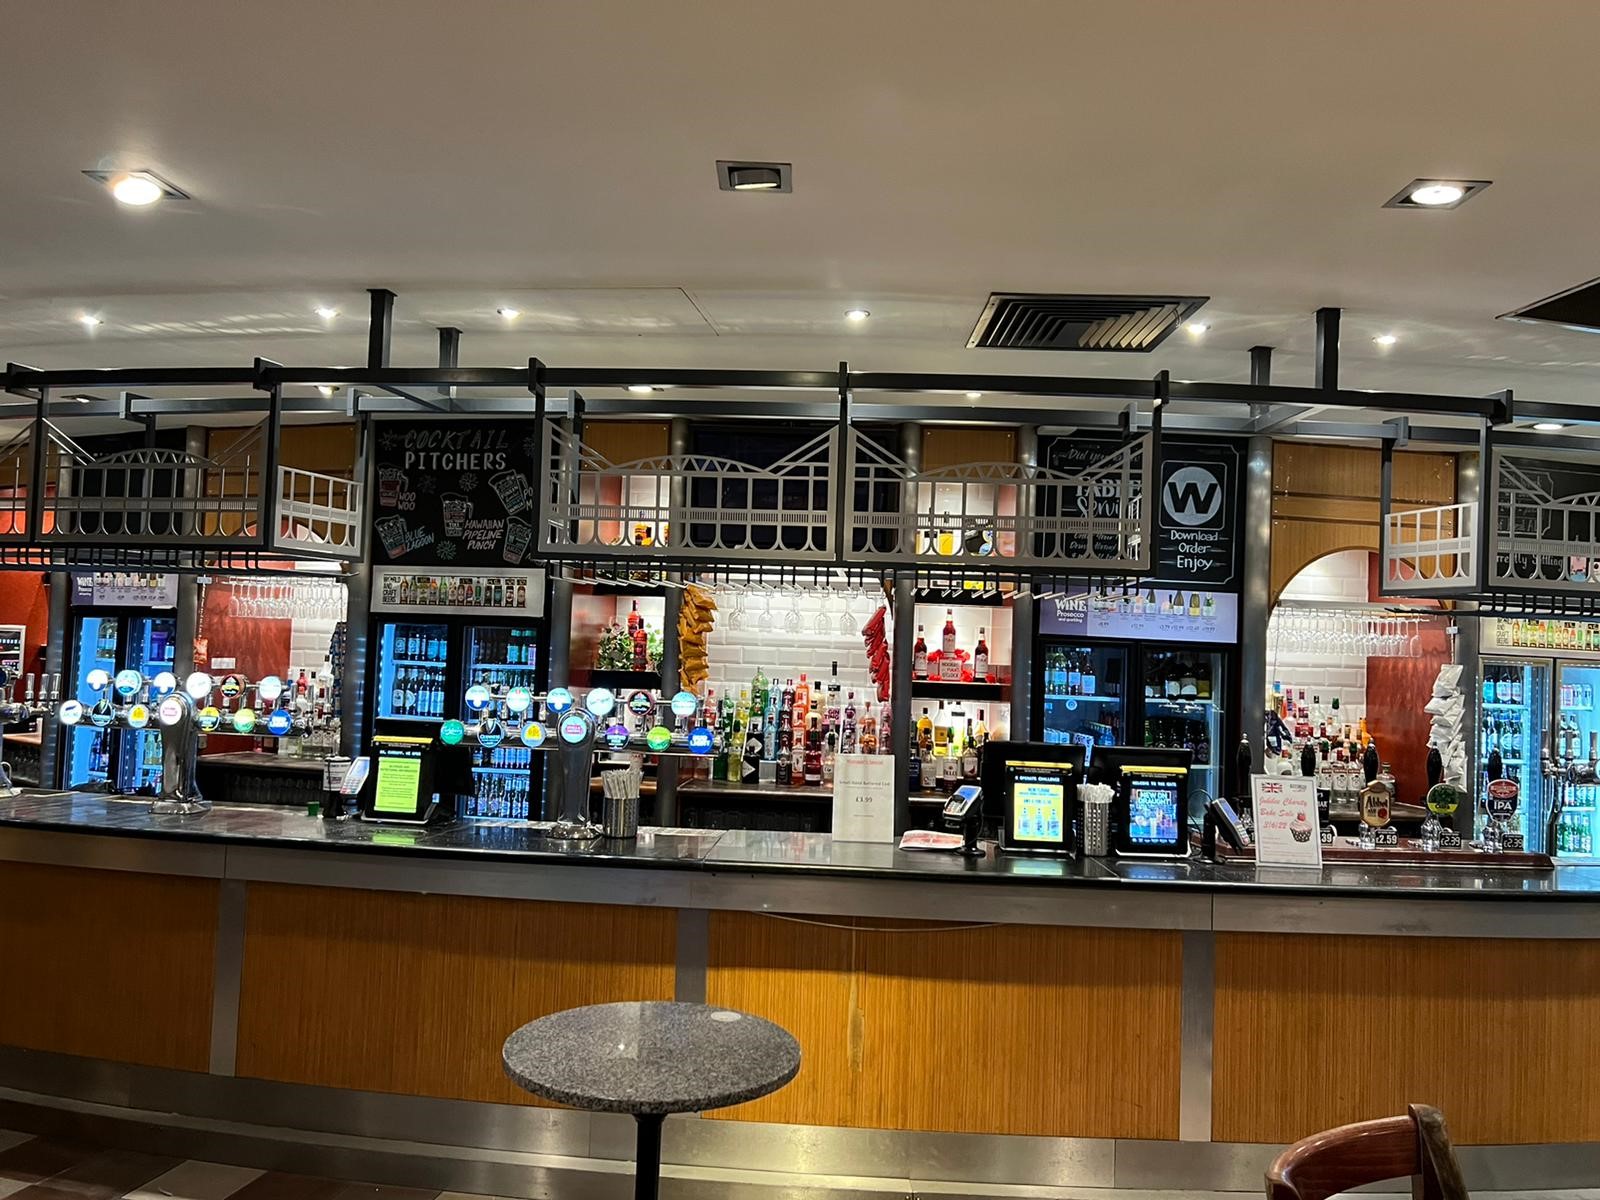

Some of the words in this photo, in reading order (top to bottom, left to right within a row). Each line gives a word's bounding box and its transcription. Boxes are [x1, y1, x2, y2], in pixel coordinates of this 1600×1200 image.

[404, 429, 508, 450] COCKTAIL
[404, 451, 507, 470] PITCHERS
[1168, 481, 1219, 514] W
[464, 519, 505, 529] HAWAIIAN
[463, 529, 504, 540] PIPELINE
[1170, 529, 1219, 542] Download
[467, 539, 496, 551] PUNCH
[1178, 541, 1211, 554] Order
[1176, 555, 1214, 573] Enjoy
[1056, 610, 1085, 618] Prosecco
[1493, 800, 1513, 810] IPA
[1376, 834, 1398, 845] £2.59
[1440, 836, 1461, 846] £2.39
